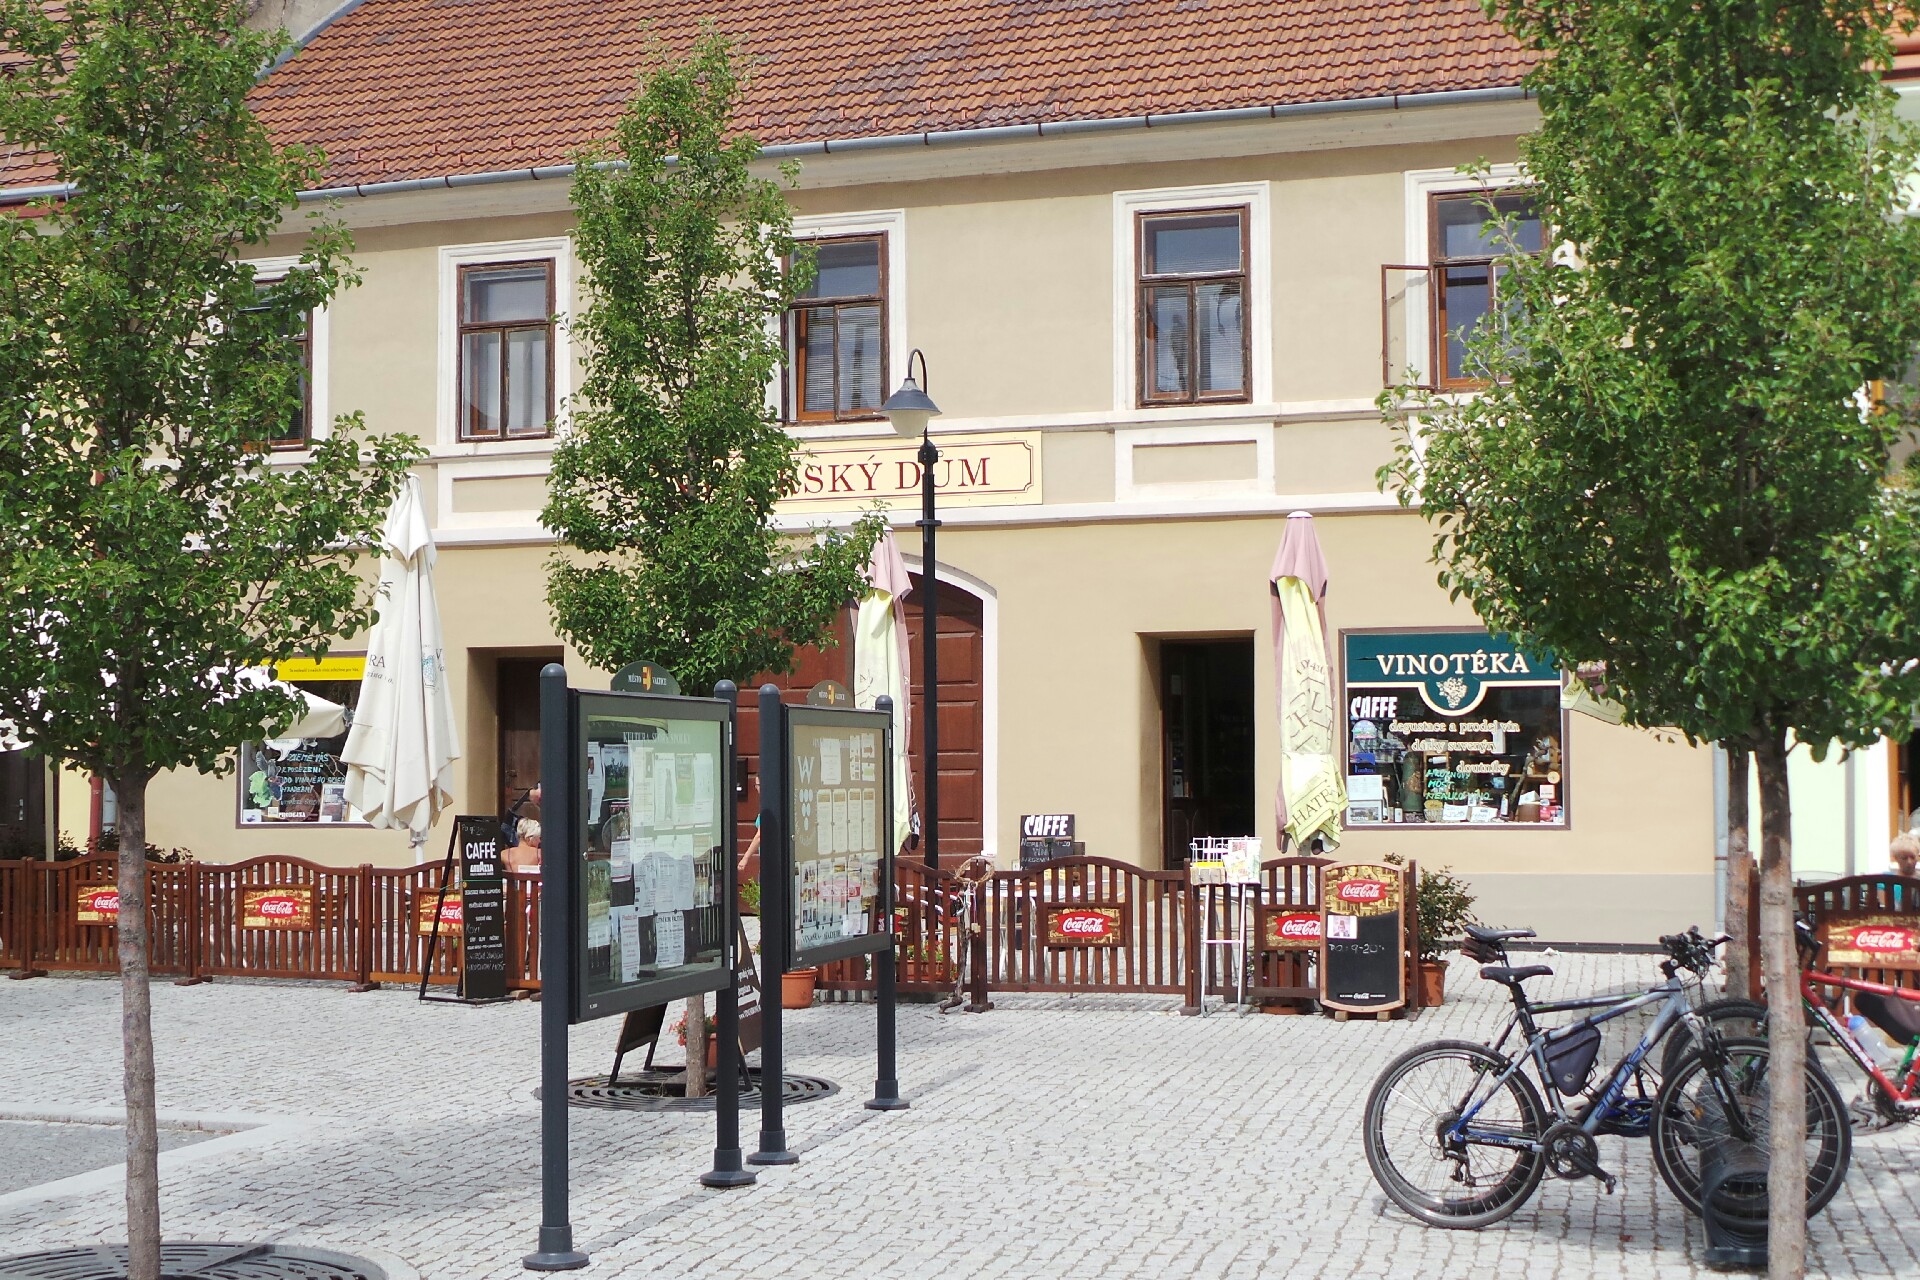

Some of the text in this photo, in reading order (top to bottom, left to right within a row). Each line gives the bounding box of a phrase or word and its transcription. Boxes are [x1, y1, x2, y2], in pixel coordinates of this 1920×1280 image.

[1376, 649, 1530, 675] VINOTÉKA
[1350, 696, 1398, 718] CAFFE
[1389, 719, 1447, 735] degustace
[1448, 722, 1457, 732] a
[1459, 719, 1498, 735] prodej
[1411, 738, 1446, 754] dárky
[1456, 760, 1511, 776] doutníky
[1024, 815, 1069, 836] CAFFE
[466, 837, 497, 860] CAFFÉ
[1341, 884, 1380, 898] Coca-Cola
[94, 896, 119, 909] Coca-Co
[261, 901, 293, 914] Coca-Cola
[440, 905, 463, 920] Coca-C
[1062, 917, 1104, 932] Coca-Cola
[1856, 931, 1905, 948] Coca-Cola
